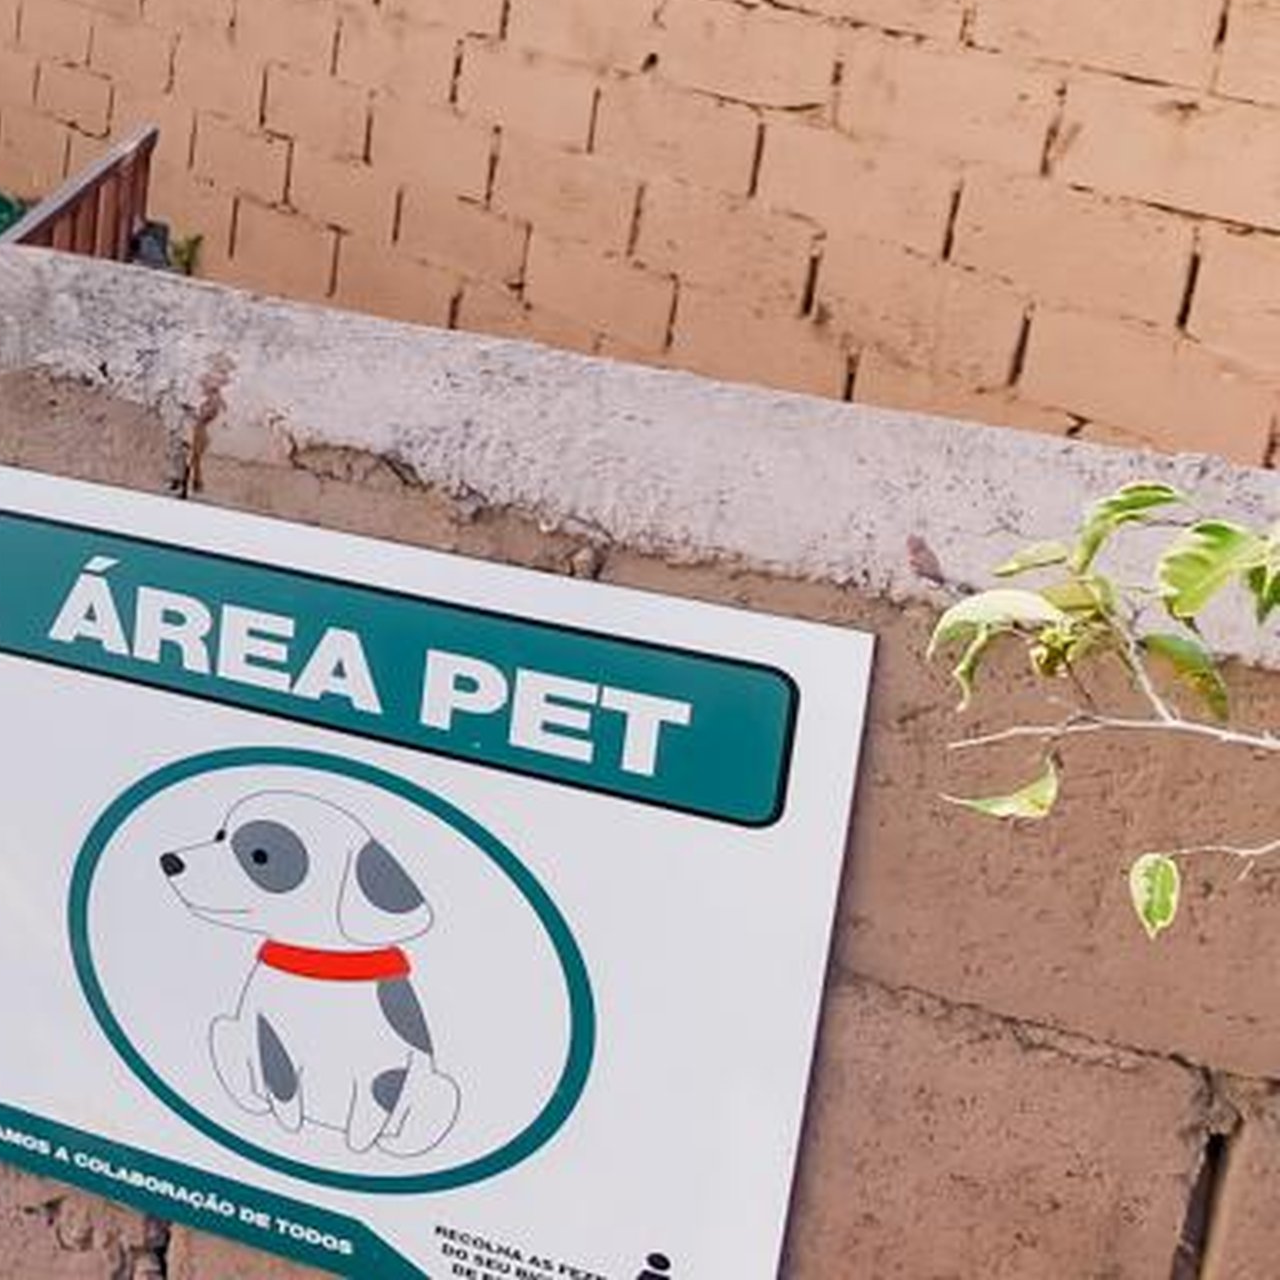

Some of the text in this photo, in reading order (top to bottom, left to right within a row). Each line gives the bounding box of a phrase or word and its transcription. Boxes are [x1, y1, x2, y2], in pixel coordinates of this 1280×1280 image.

[47, 555, 693, 777] ÁREA PET
[54, 1146, 70, 1162] A
[74, 1152, 236, 1217] COLABORAÇÃO
[240, 1206, 271, 1229] DE
[276, 1219, 355, 1255] TODOS
[434, 1225, 523, 1261] RECOLHA
[528, 1255, 554, 1272] AS
[441, 1243, 468, 1261] DO
[473, 1255, 510, 1275] SEU
